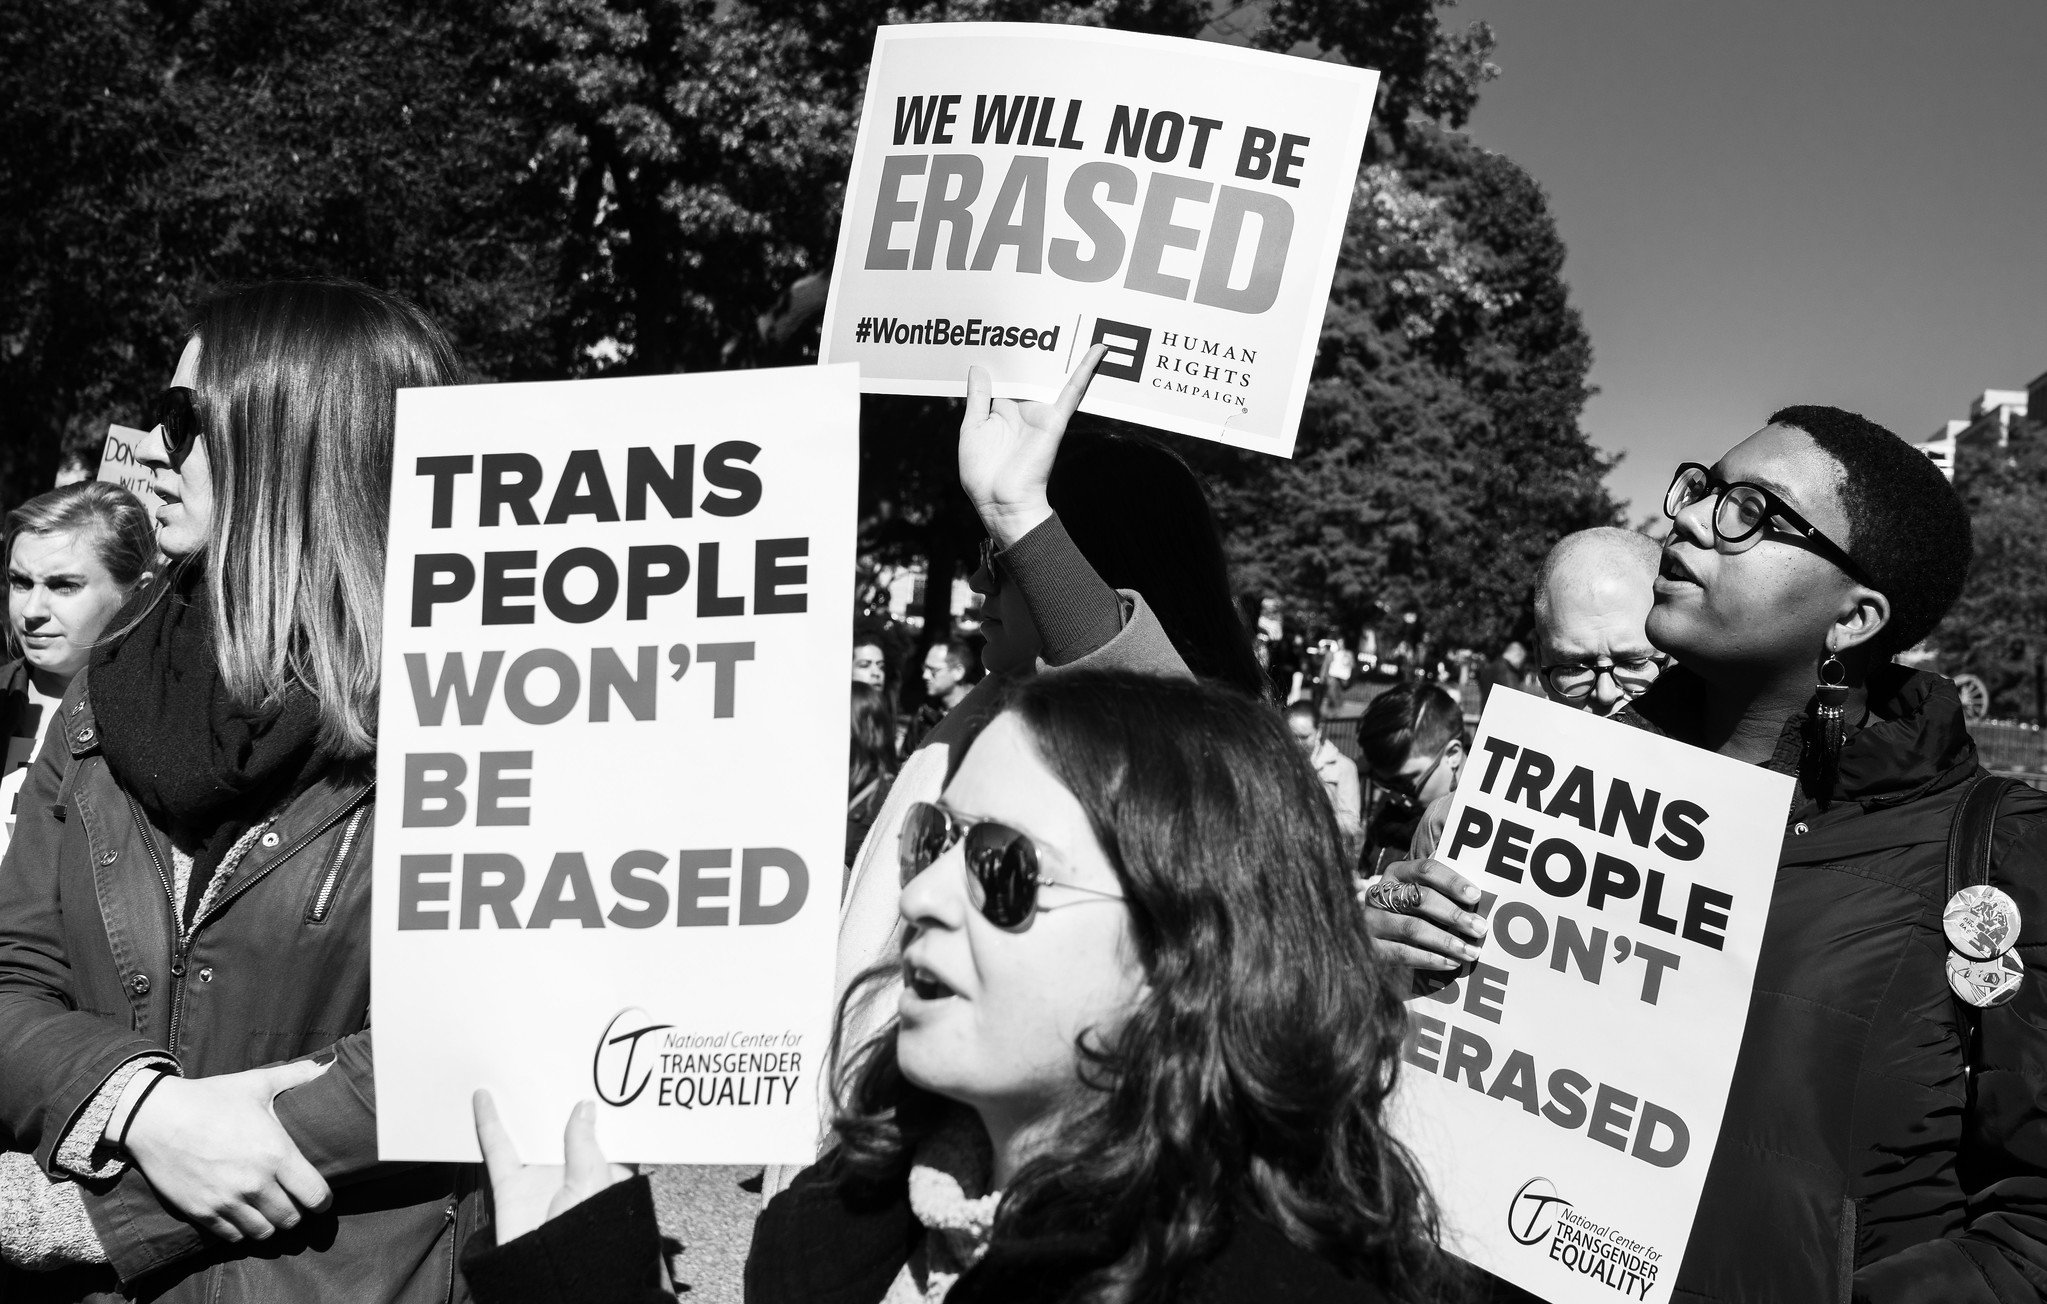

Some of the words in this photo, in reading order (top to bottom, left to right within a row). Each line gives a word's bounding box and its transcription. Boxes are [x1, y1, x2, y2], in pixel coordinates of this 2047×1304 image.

[893, 95, 962, 145] WE
[971, 95, 1084, 150] WILL
[1104, 105, 1223, 169] NOT
[1235, 126, 1310, 188] BE
[864, 154, 1294, 314] ERASED
[855, 316, 1060, 352] #WontBeErased
[1155, 354, 1251, 387] RIGHTS
[1161, 331, 1257, 364] HUMAN
[1152, 377, 1246, 407] CAMPAIGN
[416, 440, 762, 529] TRANS
[411, 537, 809, 627] PEOPLE
[404, 641, 755, 727] WON'T
[402, 751, 533, 828] BE
[1479, 735, 1710, 862] TRANS
[398, 847, 809, 931] ERASED
[1447, 805, 1734, 951] PEOPLE
[1474, 889, 1681, 1006] ON'T
[660, 1052, 802, 1073] TRANSGENDER
[663, 1031, 727, 1048] National
[731, 1030, 778, 1048] Center
[780, 1029, 803, 1048] for
[658, 1075, 800, 1110] EQUALITY
[1403, 1009, 1690, 1168] ERASED
[1549, 1237, 1654, 1302] EQUALITY
[1557, 1220, 1659, 1281] TRANSGENDER
[1561, 1208, 1610, 1237] National
[1608, 1230, 1645, 1253] Center
[1644, 1246, 1663, 1262] for
